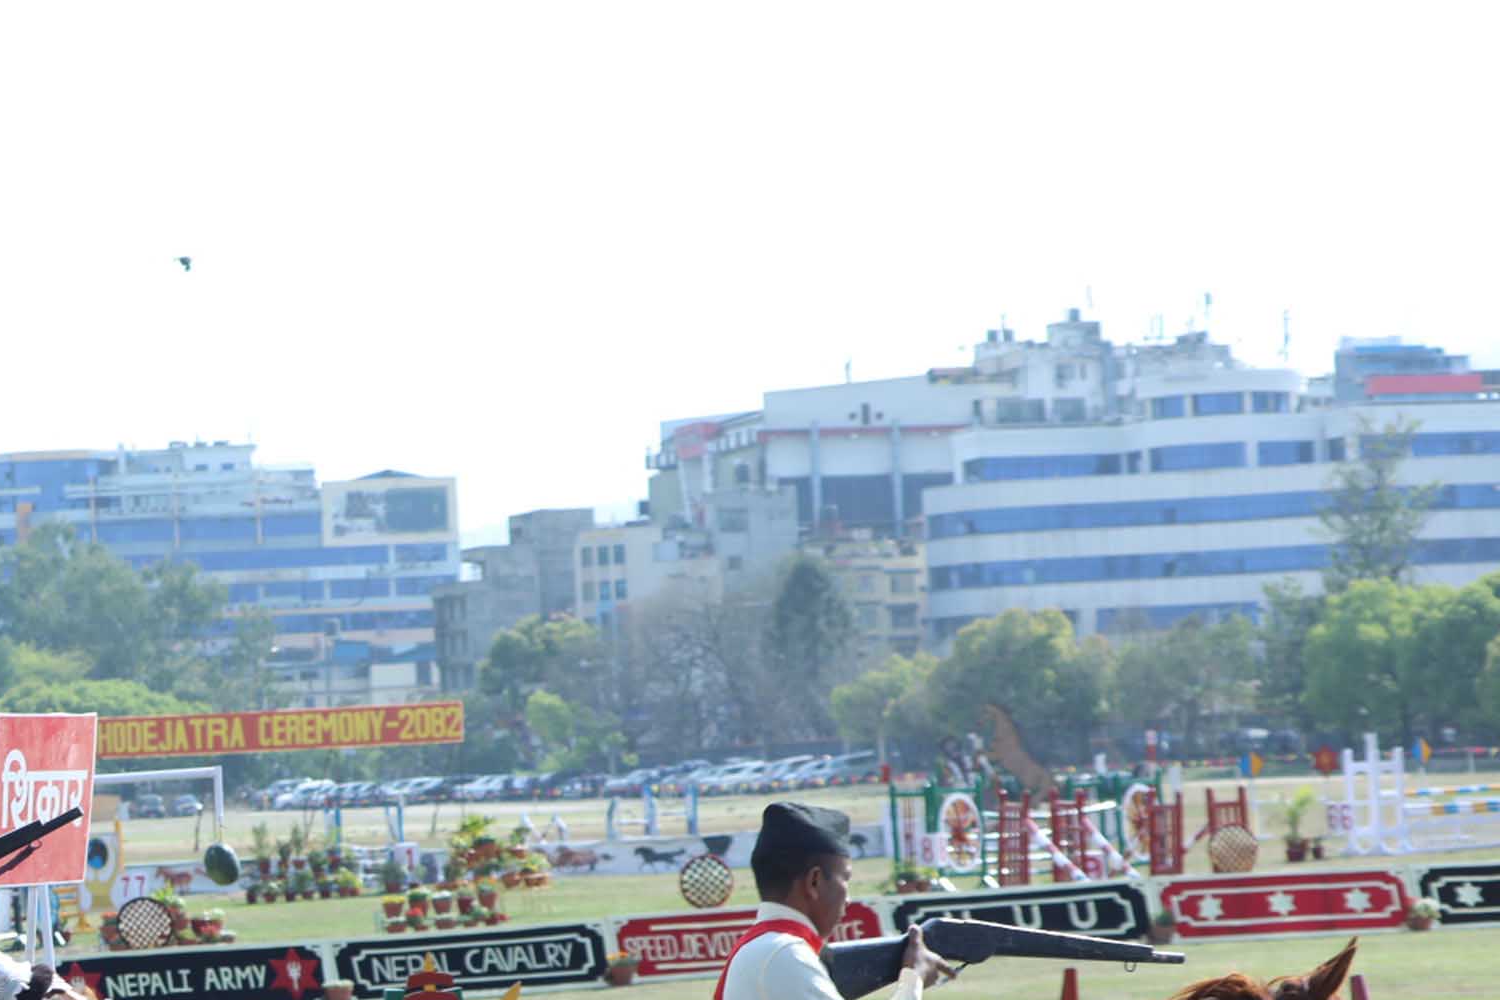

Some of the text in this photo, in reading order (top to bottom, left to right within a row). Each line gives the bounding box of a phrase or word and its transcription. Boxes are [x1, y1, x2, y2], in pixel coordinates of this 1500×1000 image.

[99, 705, 462, 754] HODEJATRA CEREMONY-2082
[1, 748, 88, 829] शिकार
[463, 942, 573, 975] CAVALRY
[104, 963, 267, 1000] NEPALI ARMY
